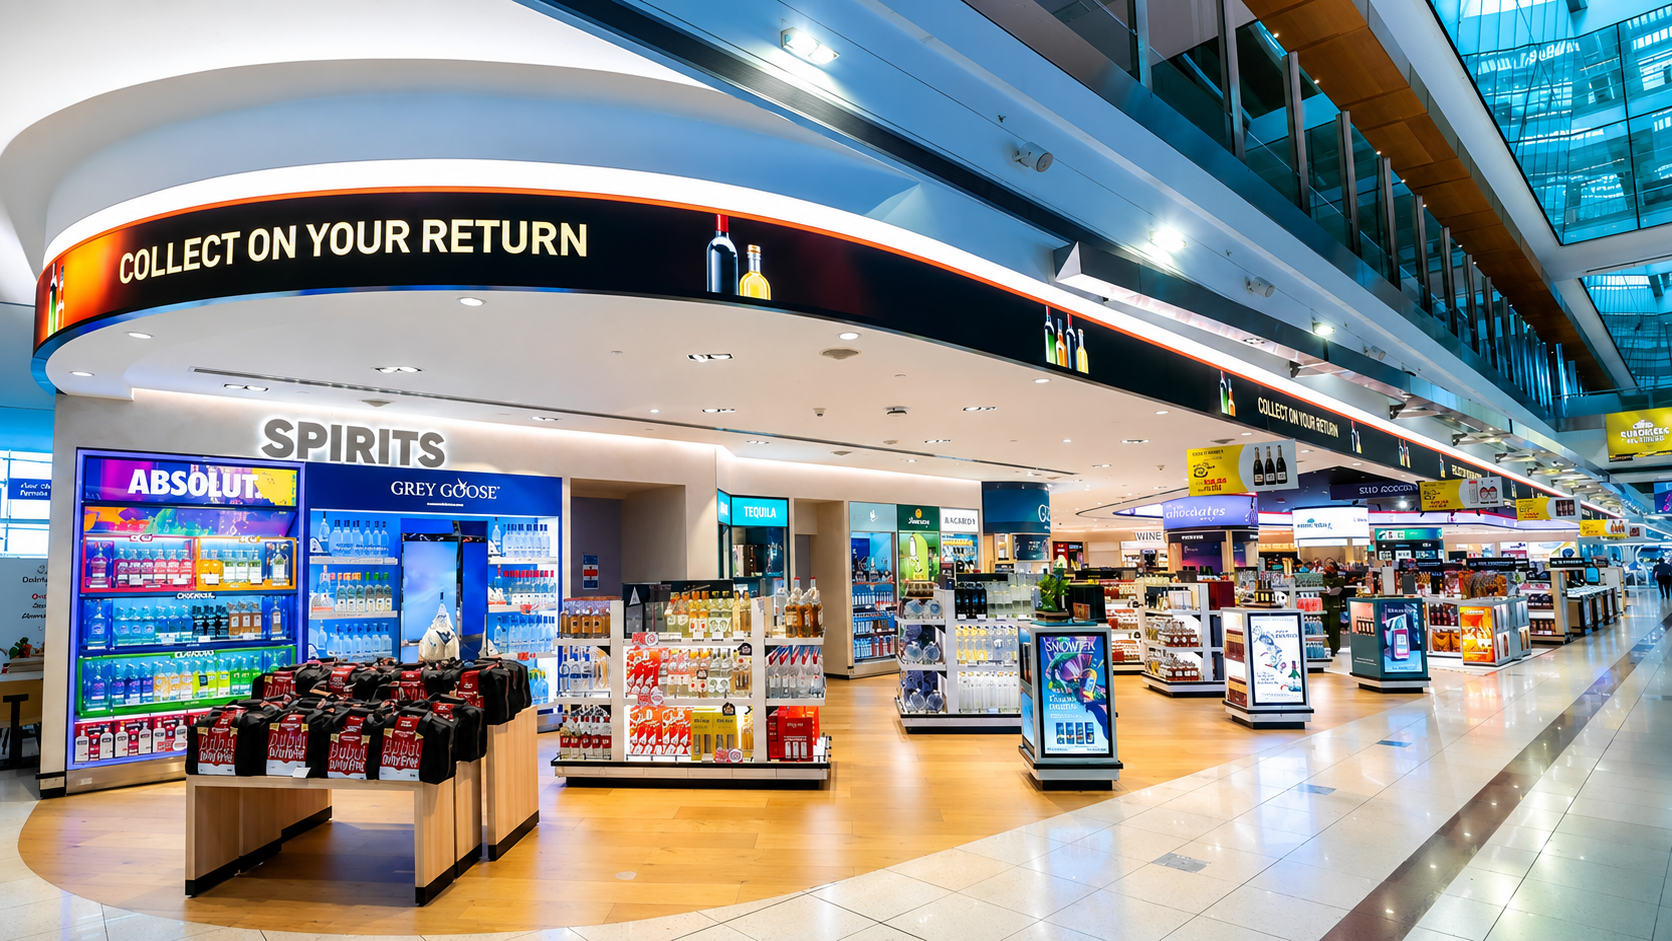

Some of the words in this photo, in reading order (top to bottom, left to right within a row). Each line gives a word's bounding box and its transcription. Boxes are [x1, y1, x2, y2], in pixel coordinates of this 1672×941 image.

[119, 231, 241, 284] COLLECT
[248, 225, 298, 262] ON
[305, 219, 410, 258] YOUR
[422, 219, 588, 257] RETURN
[1257, 396, 1288, 422] COLLECT
[1288, 408, 1299, 426] ON
[261, 418, 446, 468] SPIRITS
[390, 480, 437, 497] GREY
[439, 480, 498, 500] GOOSE
[743, 505, 777, 519] TEQUILA
[1136, 531, 1162, 541] WINE
